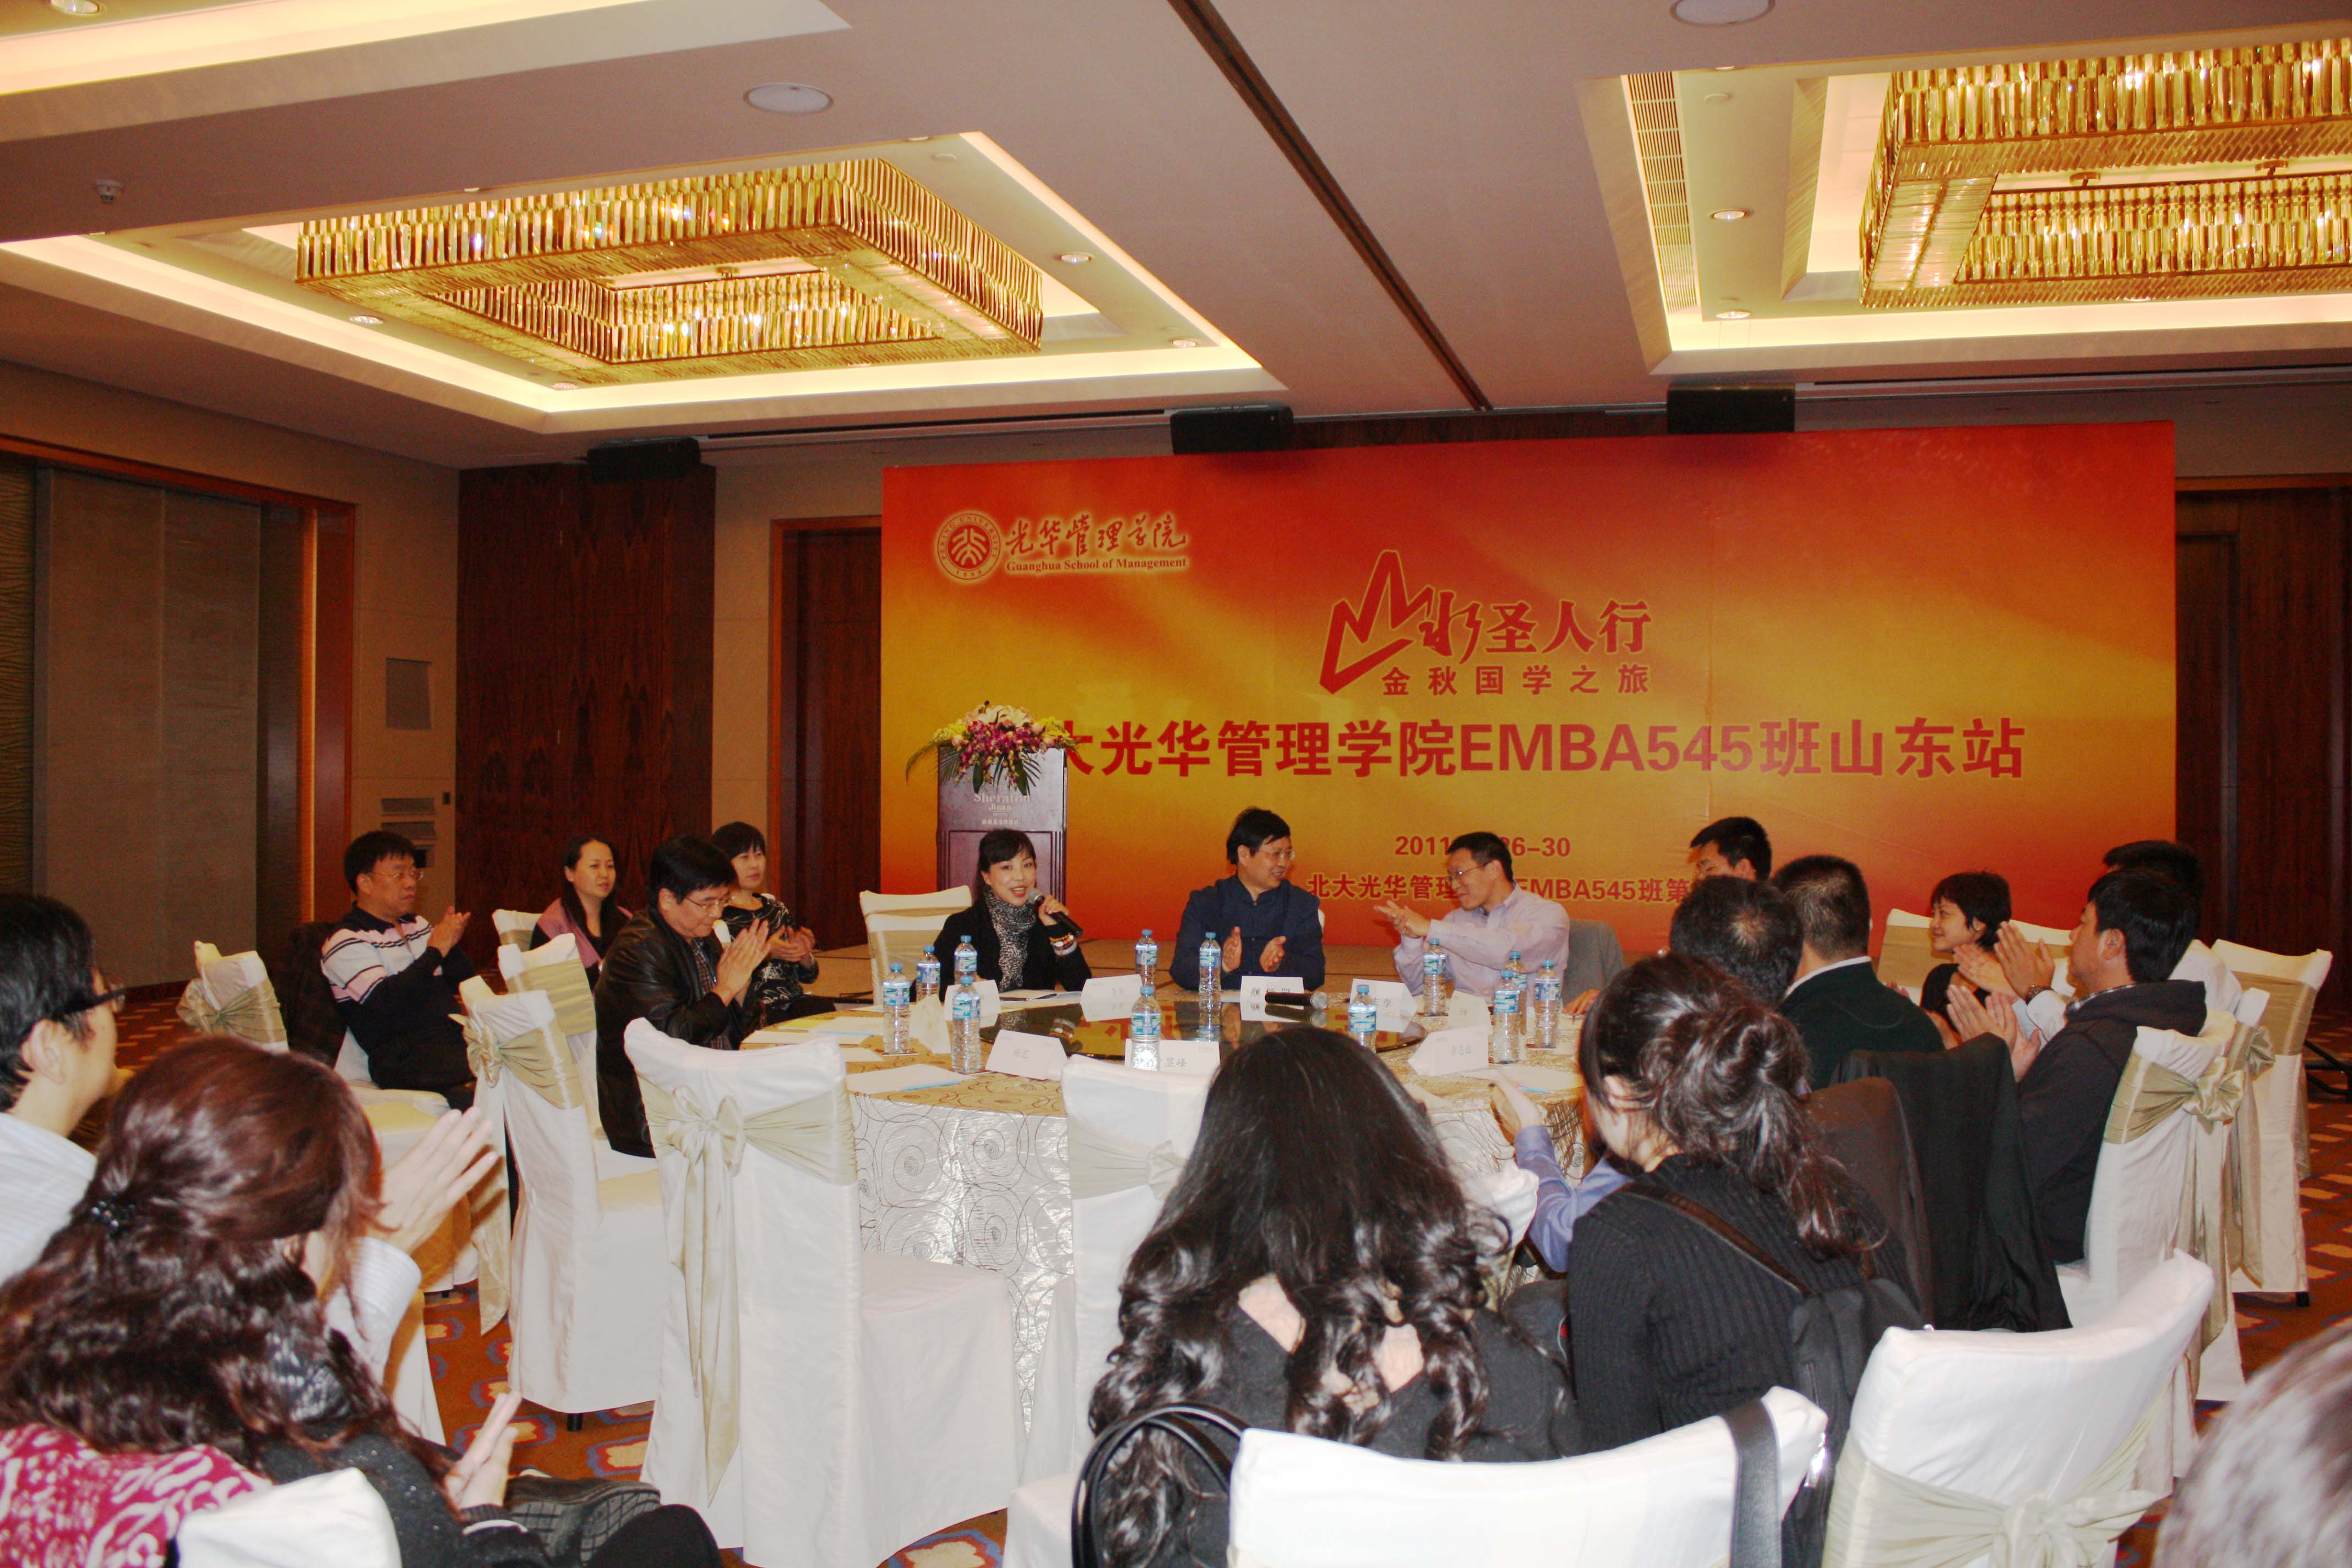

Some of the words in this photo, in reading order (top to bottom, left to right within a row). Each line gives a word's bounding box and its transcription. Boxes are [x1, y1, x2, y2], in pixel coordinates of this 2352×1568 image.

[1006, 515, 1186, 557] 光华管理学院
[1006, 560, 1061, 573] Guanghua
[1064, 559, 1099, 570] School
[1102, 558, 1115, 569] of
[1117, 558, 1186, 570] Management
[1381, 663, 1650, 696] 金秋国学之旅
